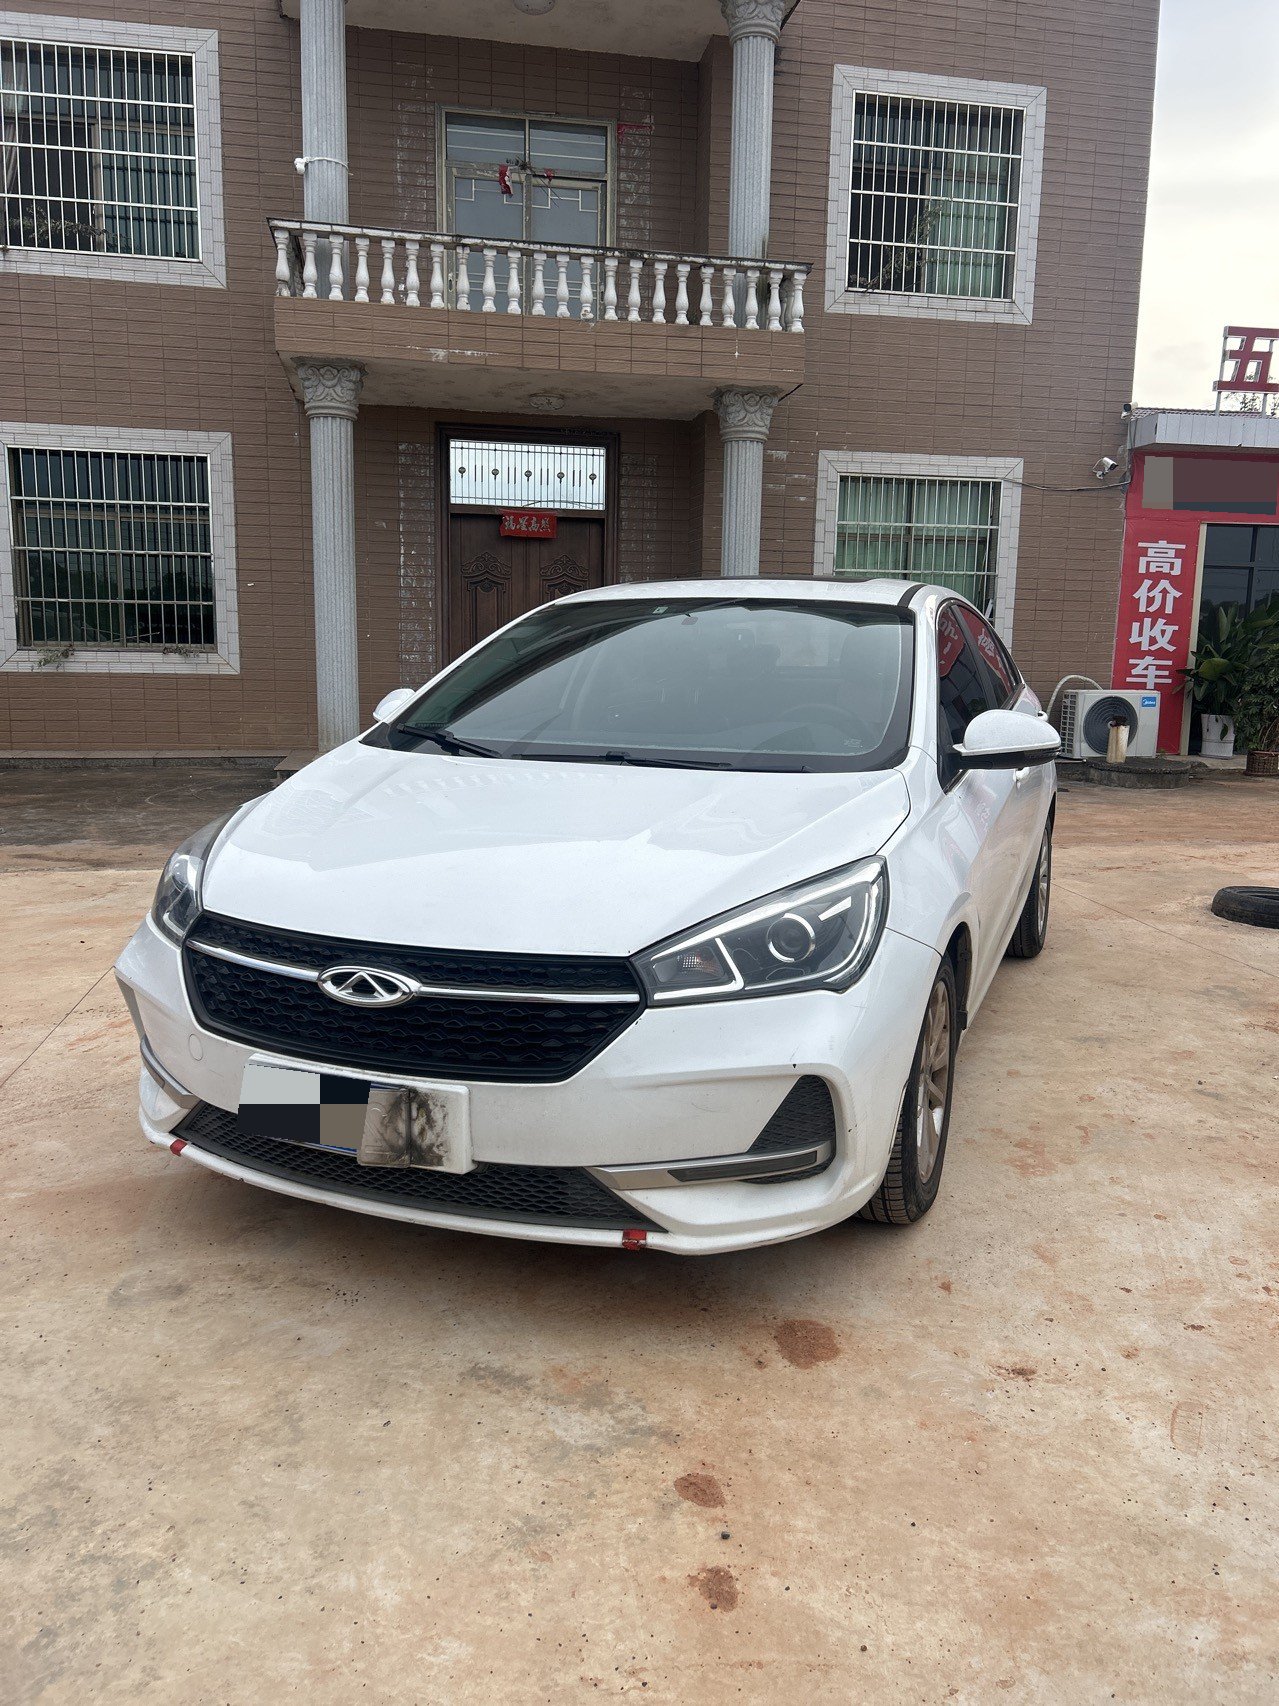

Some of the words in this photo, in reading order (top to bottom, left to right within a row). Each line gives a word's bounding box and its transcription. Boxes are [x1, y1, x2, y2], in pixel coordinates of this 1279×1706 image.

[1213, 326, 1279, 393] 五
[1125, 540, 1186, 690] 高价收车
